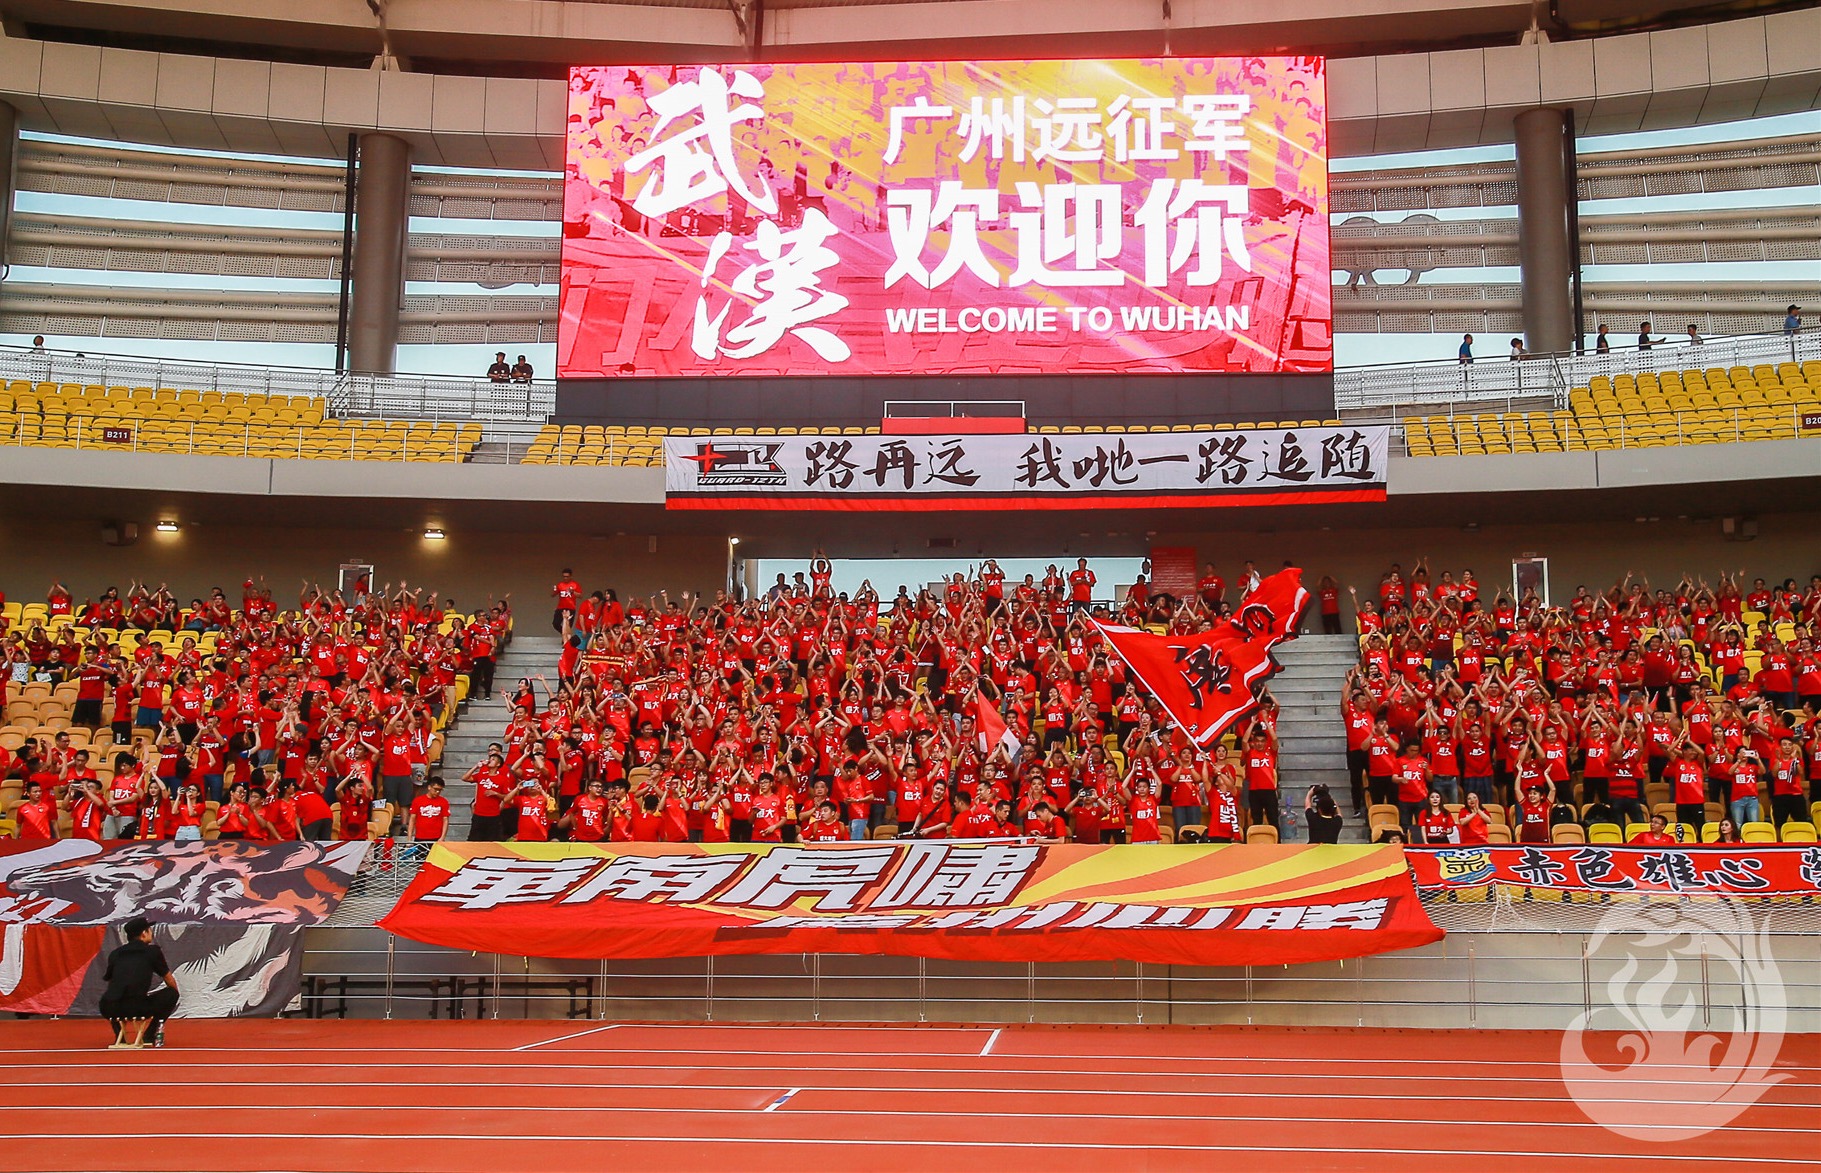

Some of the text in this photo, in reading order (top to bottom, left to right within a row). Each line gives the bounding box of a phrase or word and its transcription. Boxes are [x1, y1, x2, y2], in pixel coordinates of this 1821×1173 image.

[883, 95, 1252, 166] 广州远征军
[884, 179, 1252, 290] 欢迎你
[886, 305, 1250, 333] WELCOME TO WUHAN
[803, 431, 1376, 489] 路再远 我哋一路追随
[1508, 847, 1772, 892] 赤色雄心
